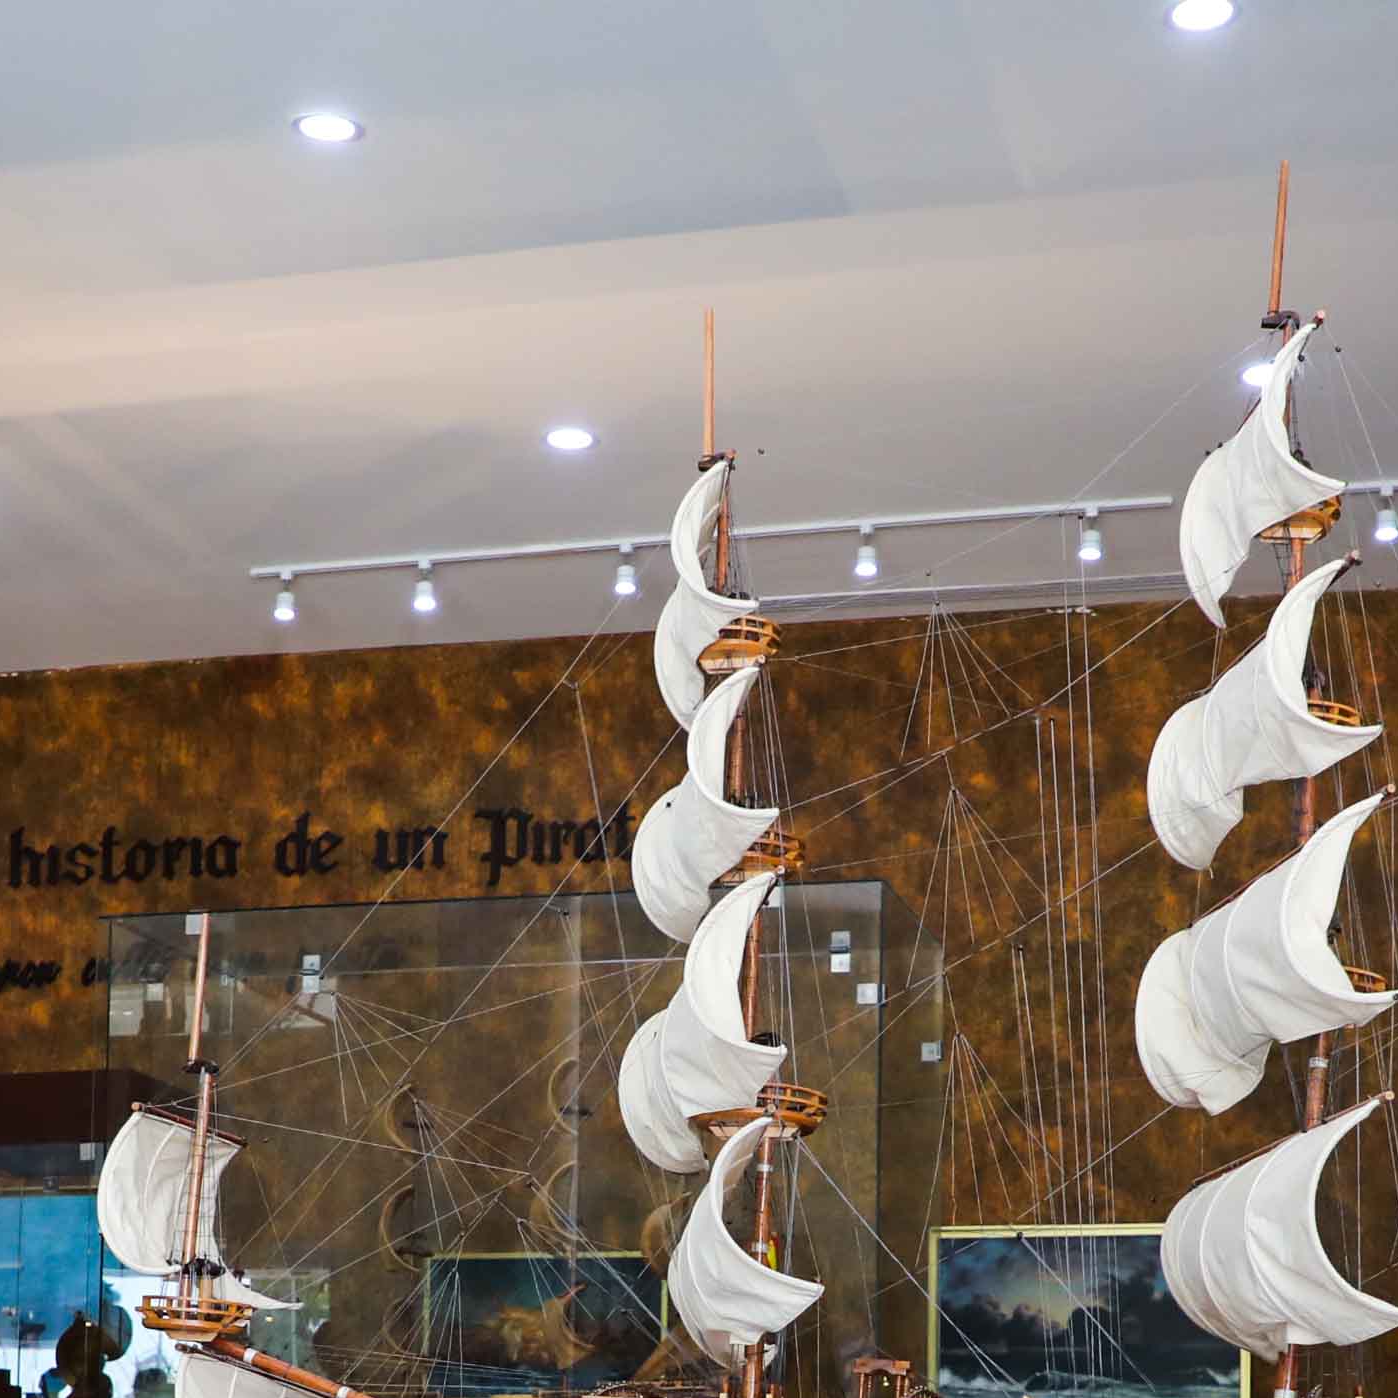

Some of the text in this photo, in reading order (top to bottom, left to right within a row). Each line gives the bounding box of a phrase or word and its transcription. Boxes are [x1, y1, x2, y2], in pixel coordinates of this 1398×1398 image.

[7, 825, 242, 890] historia
[275, 811, 345, 878] de
[372, 821, 449, 872] un
[475, 803, 638, 887] Pirat
